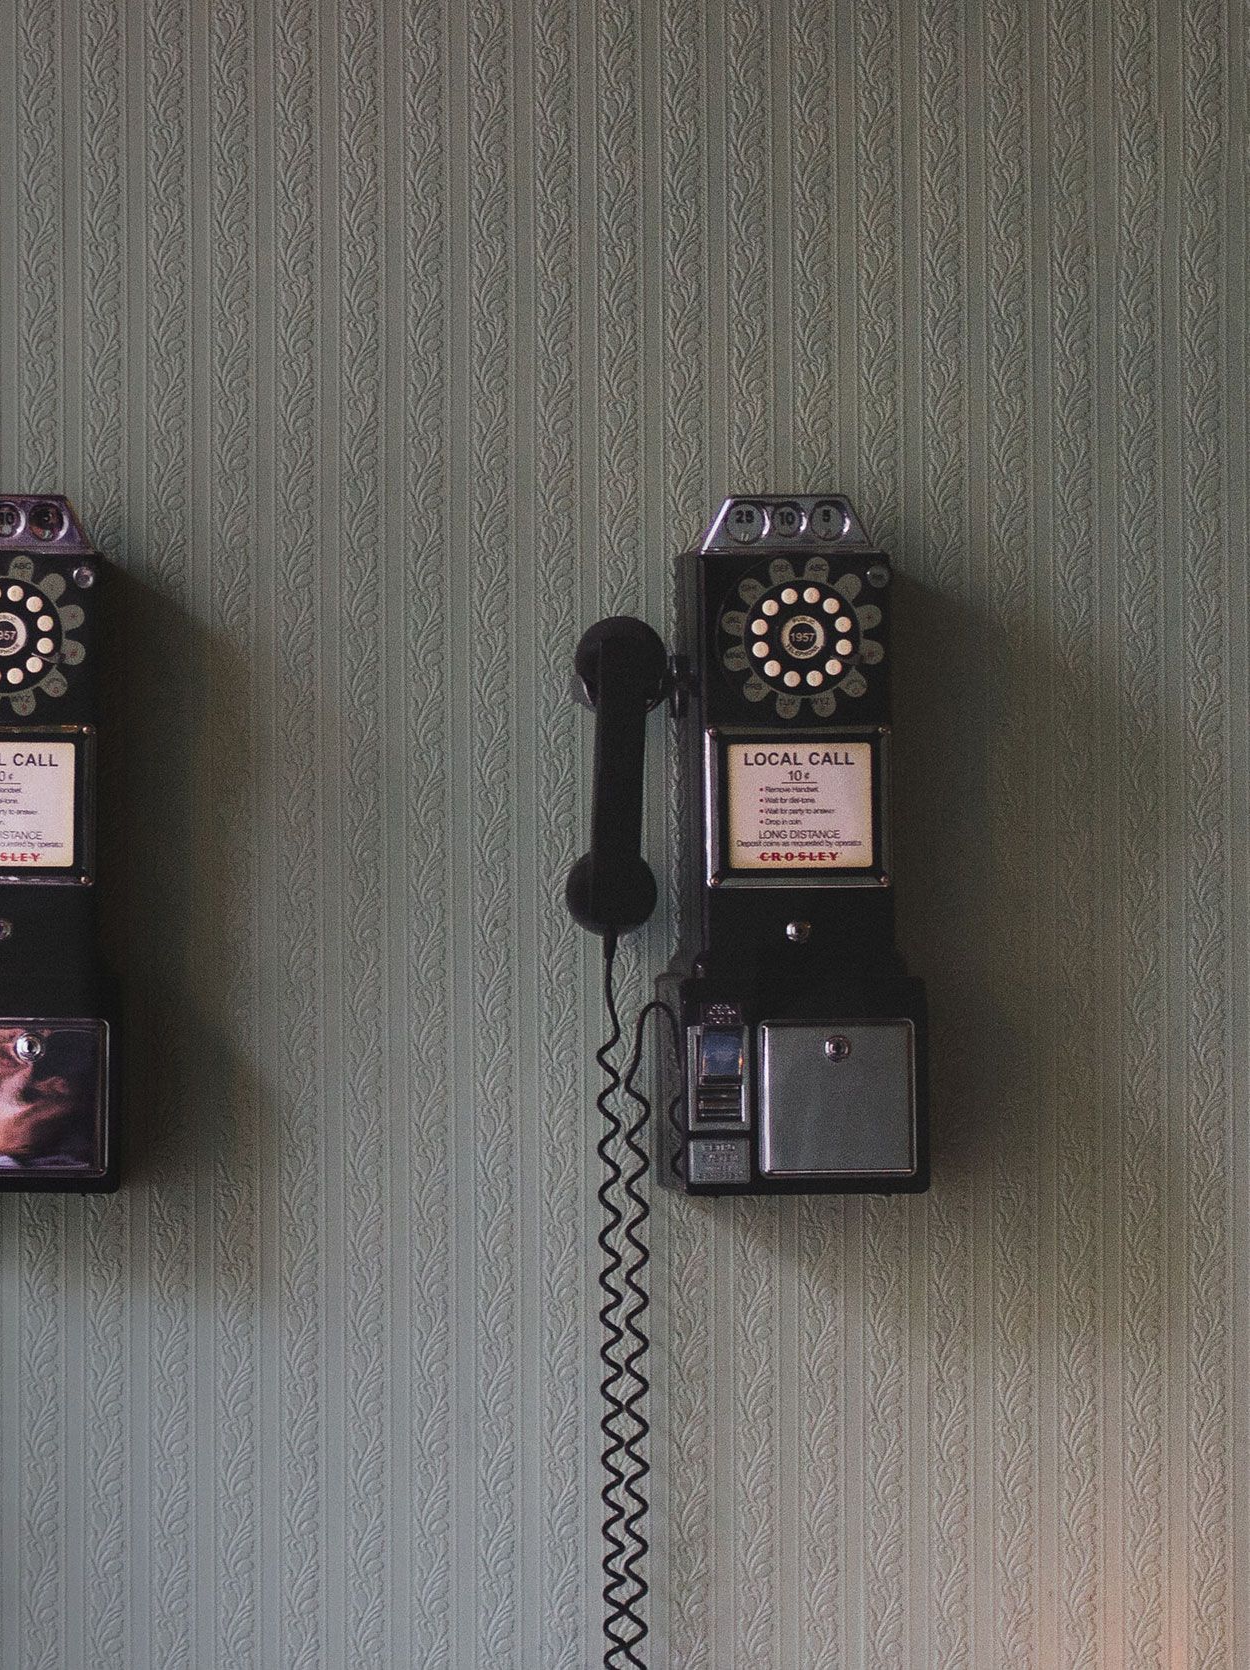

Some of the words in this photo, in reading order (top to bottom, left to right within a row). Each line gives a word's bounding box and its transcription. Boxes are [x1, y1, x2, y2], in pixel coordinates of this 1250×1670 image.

[736, 510, 755, 523] 25
[779, 511, 795, 525] 10
[822, 509, 831, 522] 5
[790, 632, 816, 642] 1957
[13, 753, 59, 767] CALL
[743, 752, 803, 766] LOCAL
[809, 752, 855, 765] CALL
[788, 770, 802, 781] 10
[765, 818, 781, 826] Drop
[758, 830, 788, 839] LONG
[789, 829, 841, 839] DISTANCE
[791, 840, 824, 848] requested
[758, 852, 839, 862] CROSLEY
